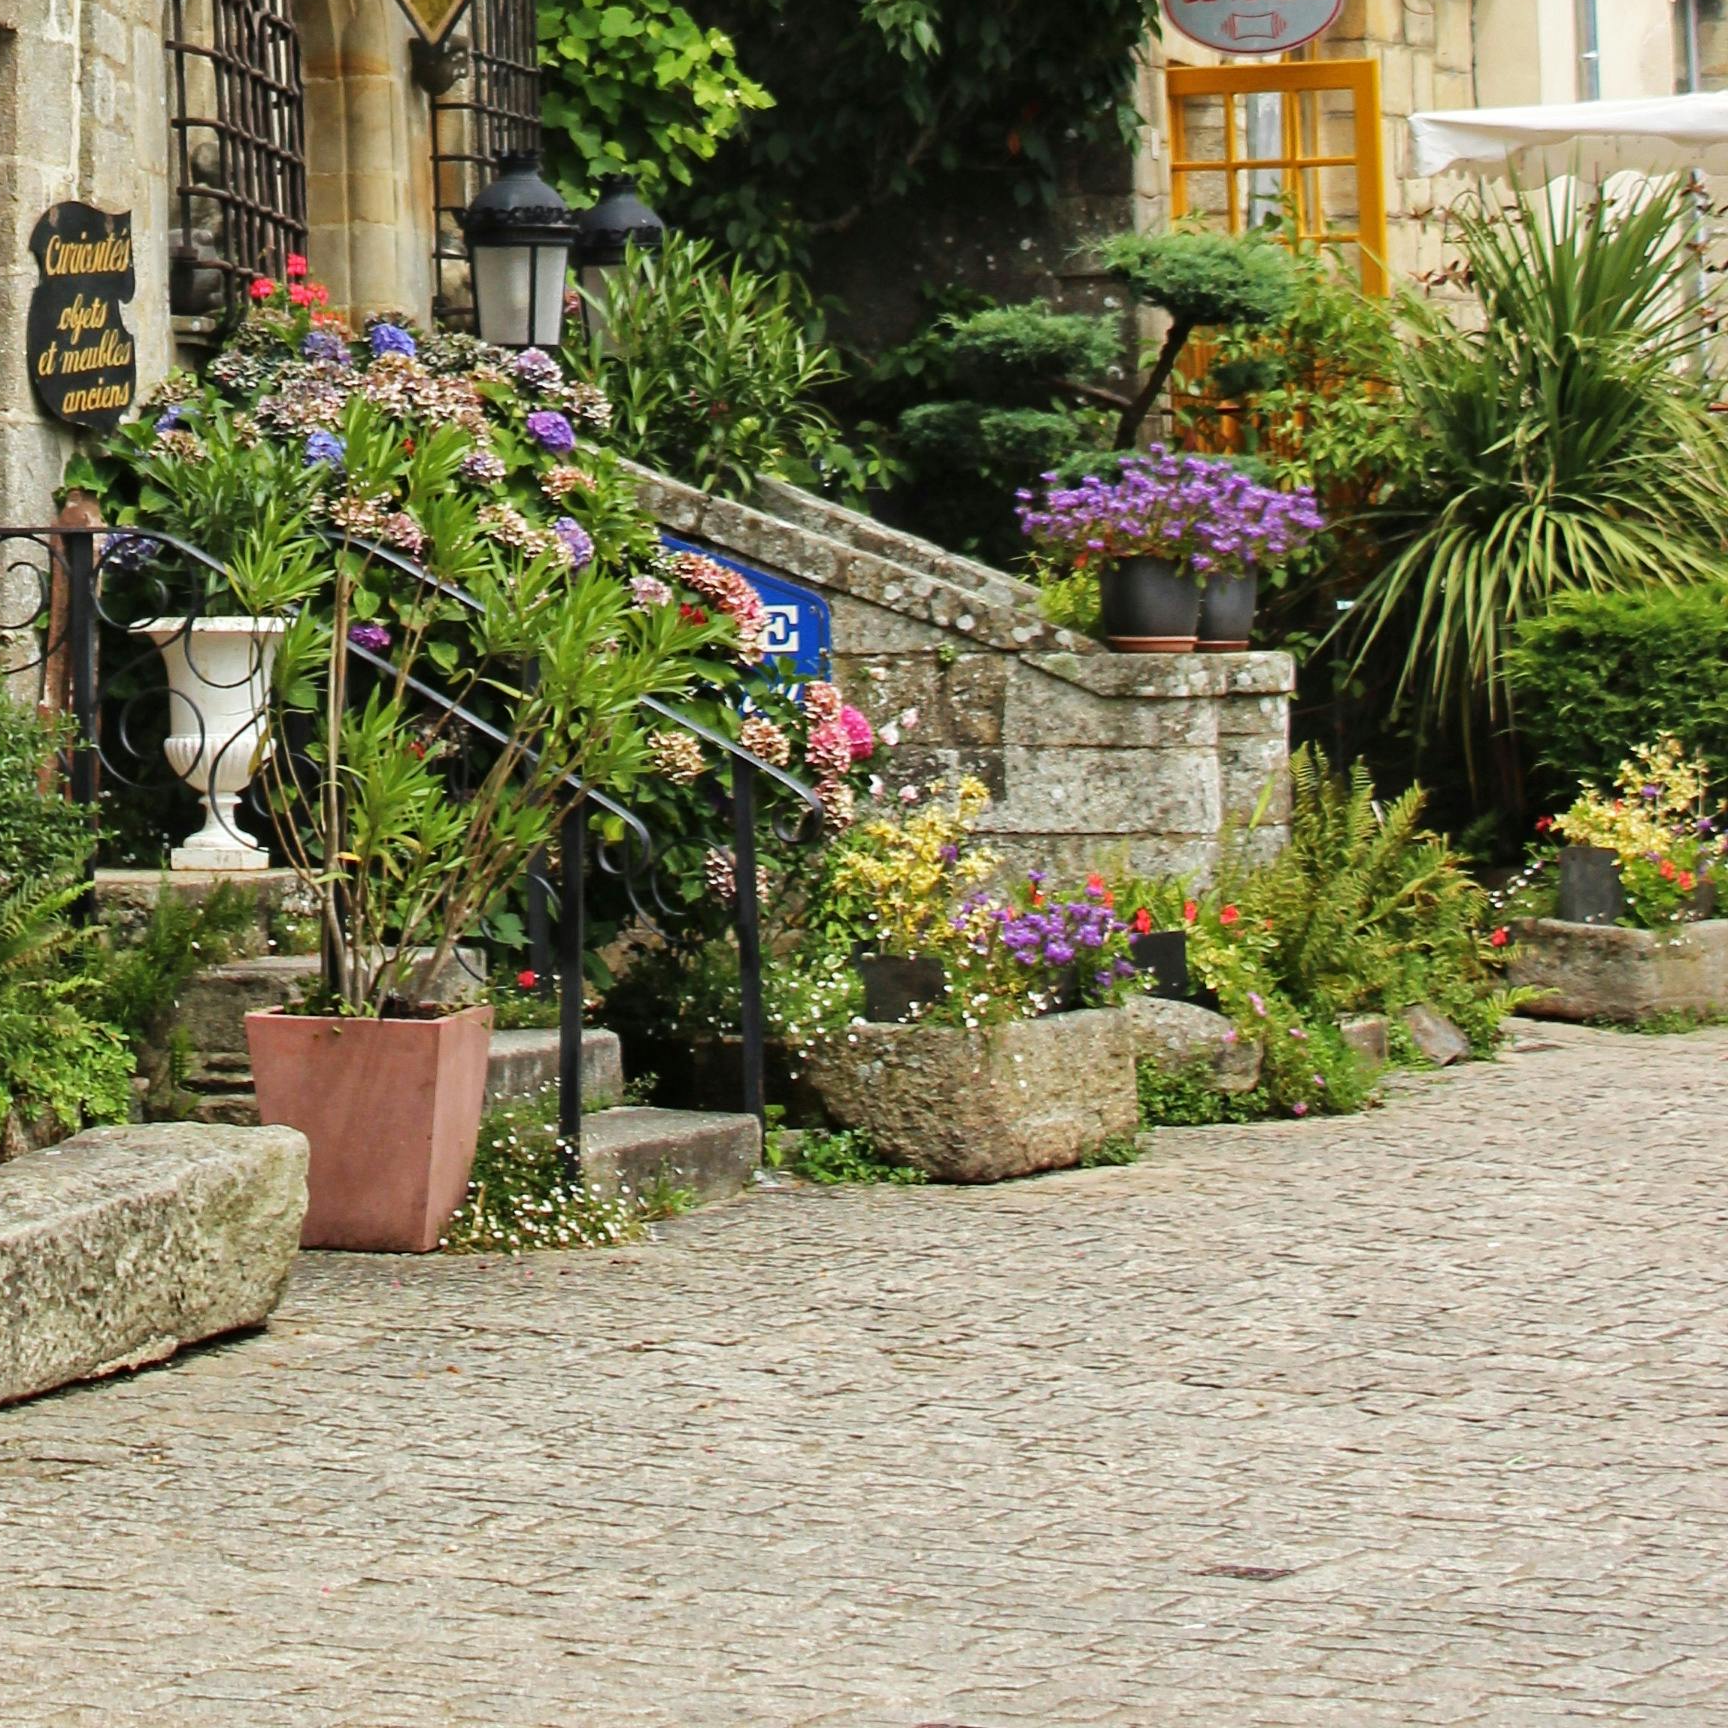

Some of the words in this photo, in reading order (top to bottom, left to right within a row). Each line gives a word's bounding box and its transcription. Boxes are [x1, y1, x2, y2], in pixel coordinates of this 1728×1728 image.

[45, 227, 132, 277] Curiosités
[57, 293, 108, 346] objets
[38, 340, 58, 377] et
[59, 328, 132, 375] meubles
[62, 377, 130, 415] anciens
